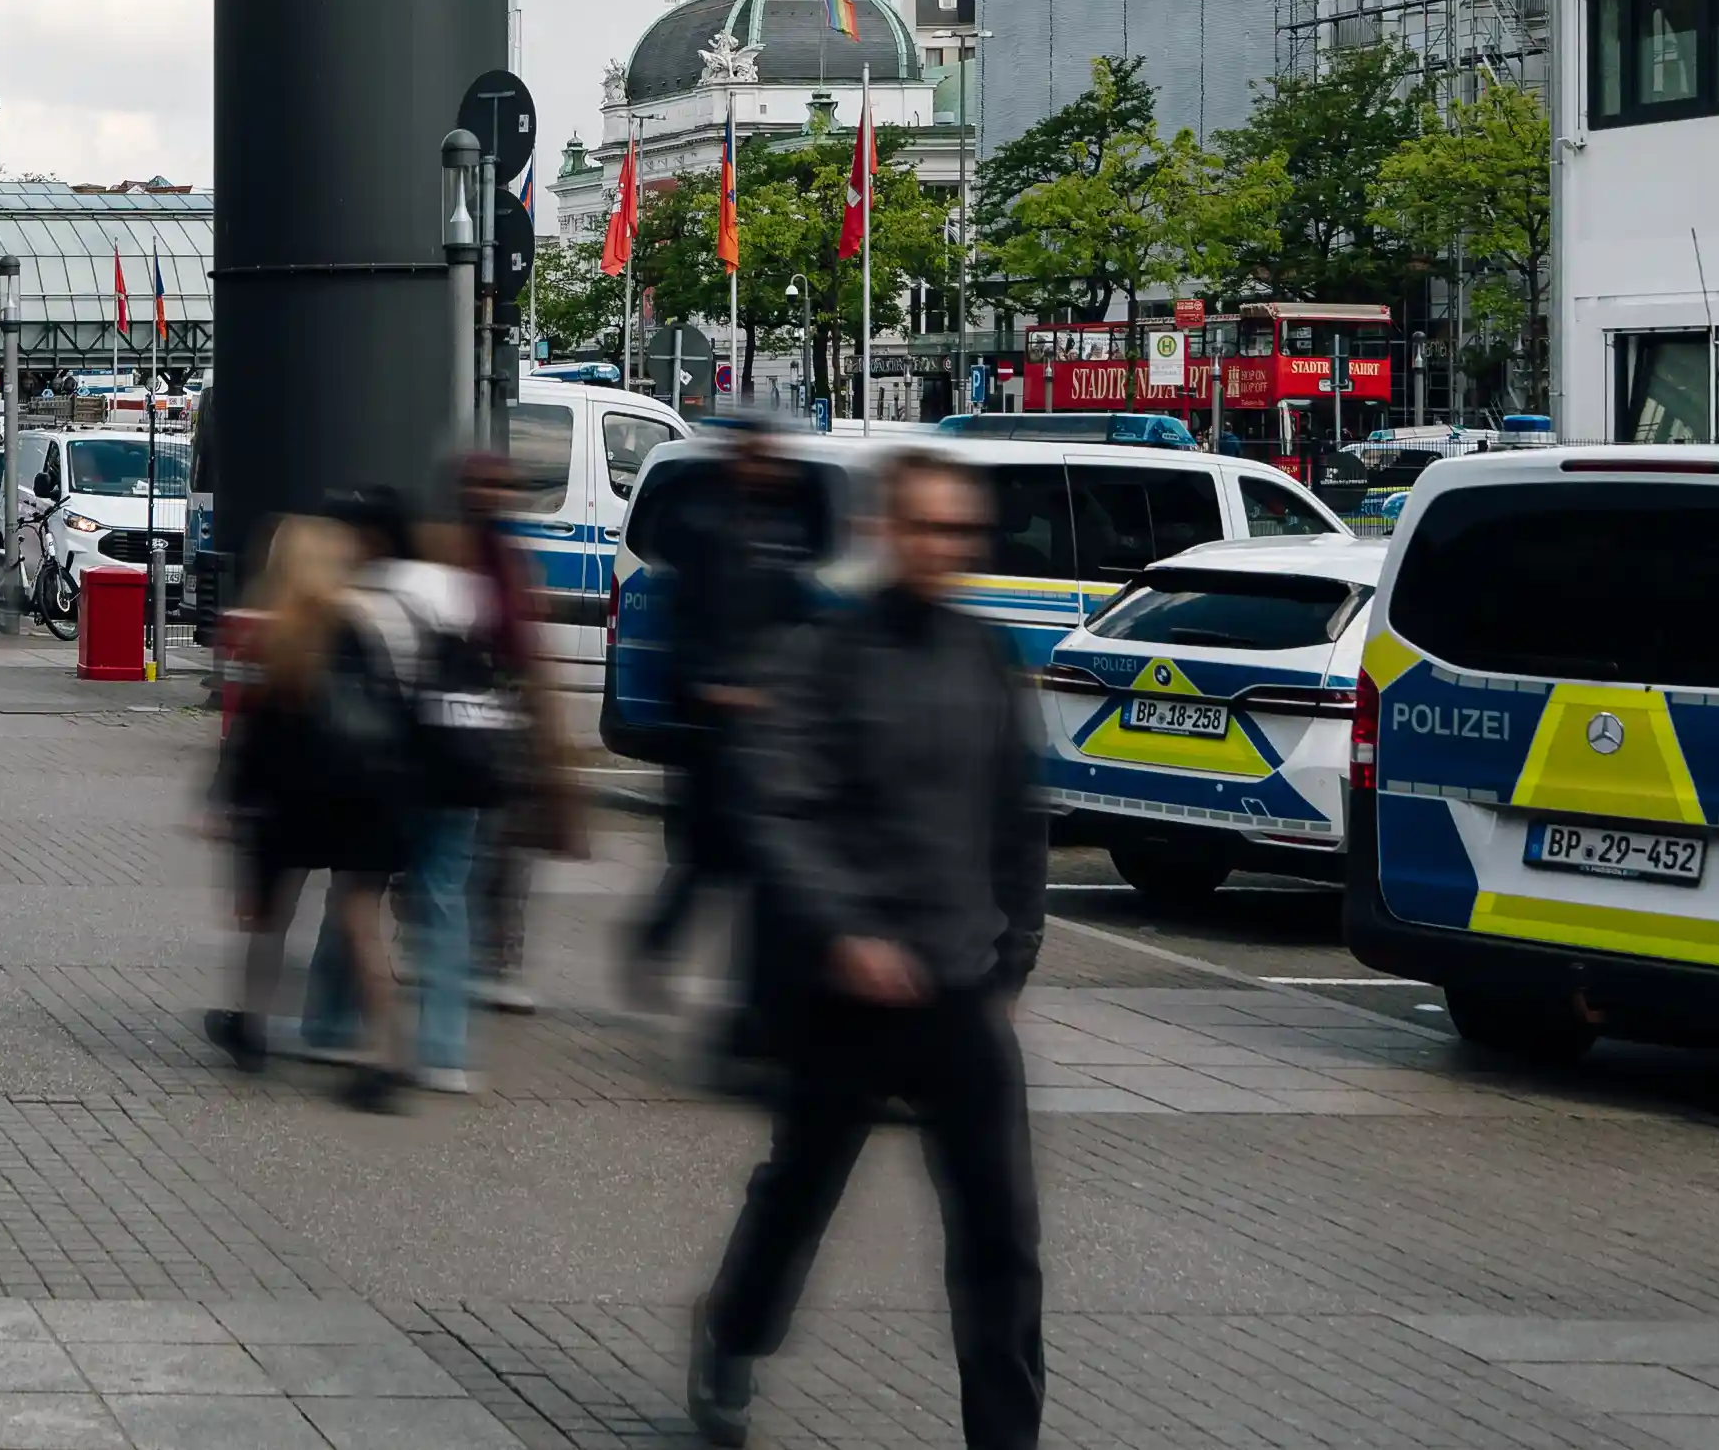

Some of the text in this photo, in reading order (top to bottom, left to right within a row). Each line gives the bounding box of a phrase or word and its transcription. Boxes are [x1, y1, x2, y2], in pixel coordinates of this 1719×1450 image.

[1093, 656, 1138, 672] POLIZEI
[1136, 701, 1222, 730] BP 18-258
[1392, 702, 1510, 741] POLIZEI
[1547, 828, 1581, 858] BP
[1598, 833, 1697, 873] 29-452
